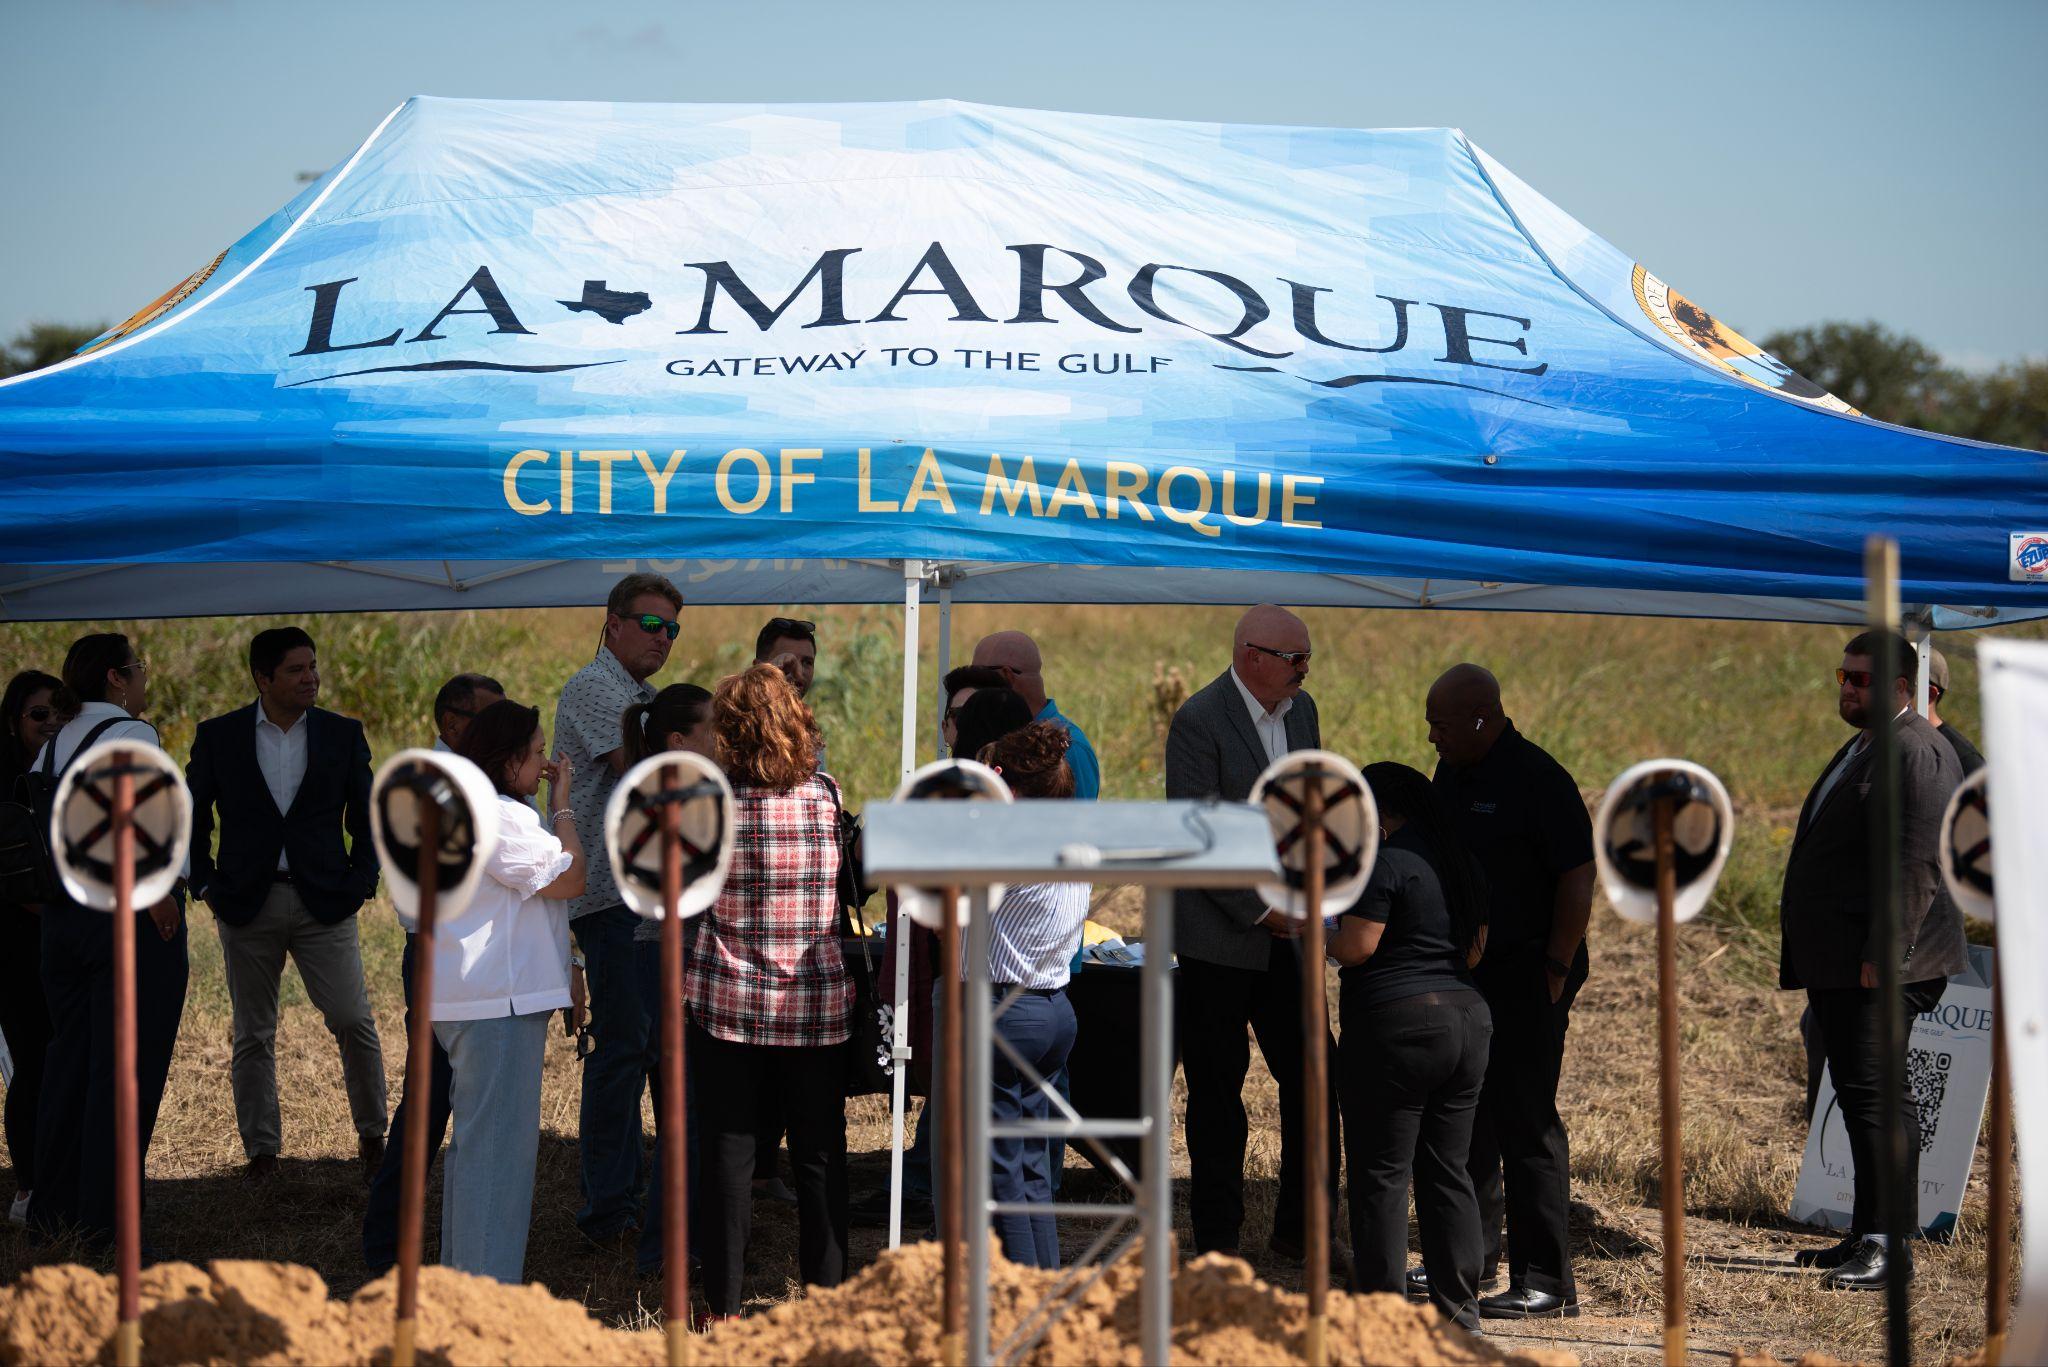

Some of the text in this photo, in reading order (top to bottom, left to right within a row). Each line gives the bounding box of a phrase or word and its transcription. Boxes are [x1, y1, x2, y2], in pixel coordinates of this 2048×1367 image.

[289, 266, 537, 358] LA
[676, 241, 1549, 377] MARQUE
[666, 347, 1169, 377] GATEWAY TO THE GULF
[503, 447, 1324, 537] CITY OF LA MARQUE
[1919, 1027, 1929, 1035] THE
[1930, 1029, 1945, 1037] GULF
[1920, 1003, 1993, 1031] RQUE
[1825, 1163, 1945, 1195] LA TV
